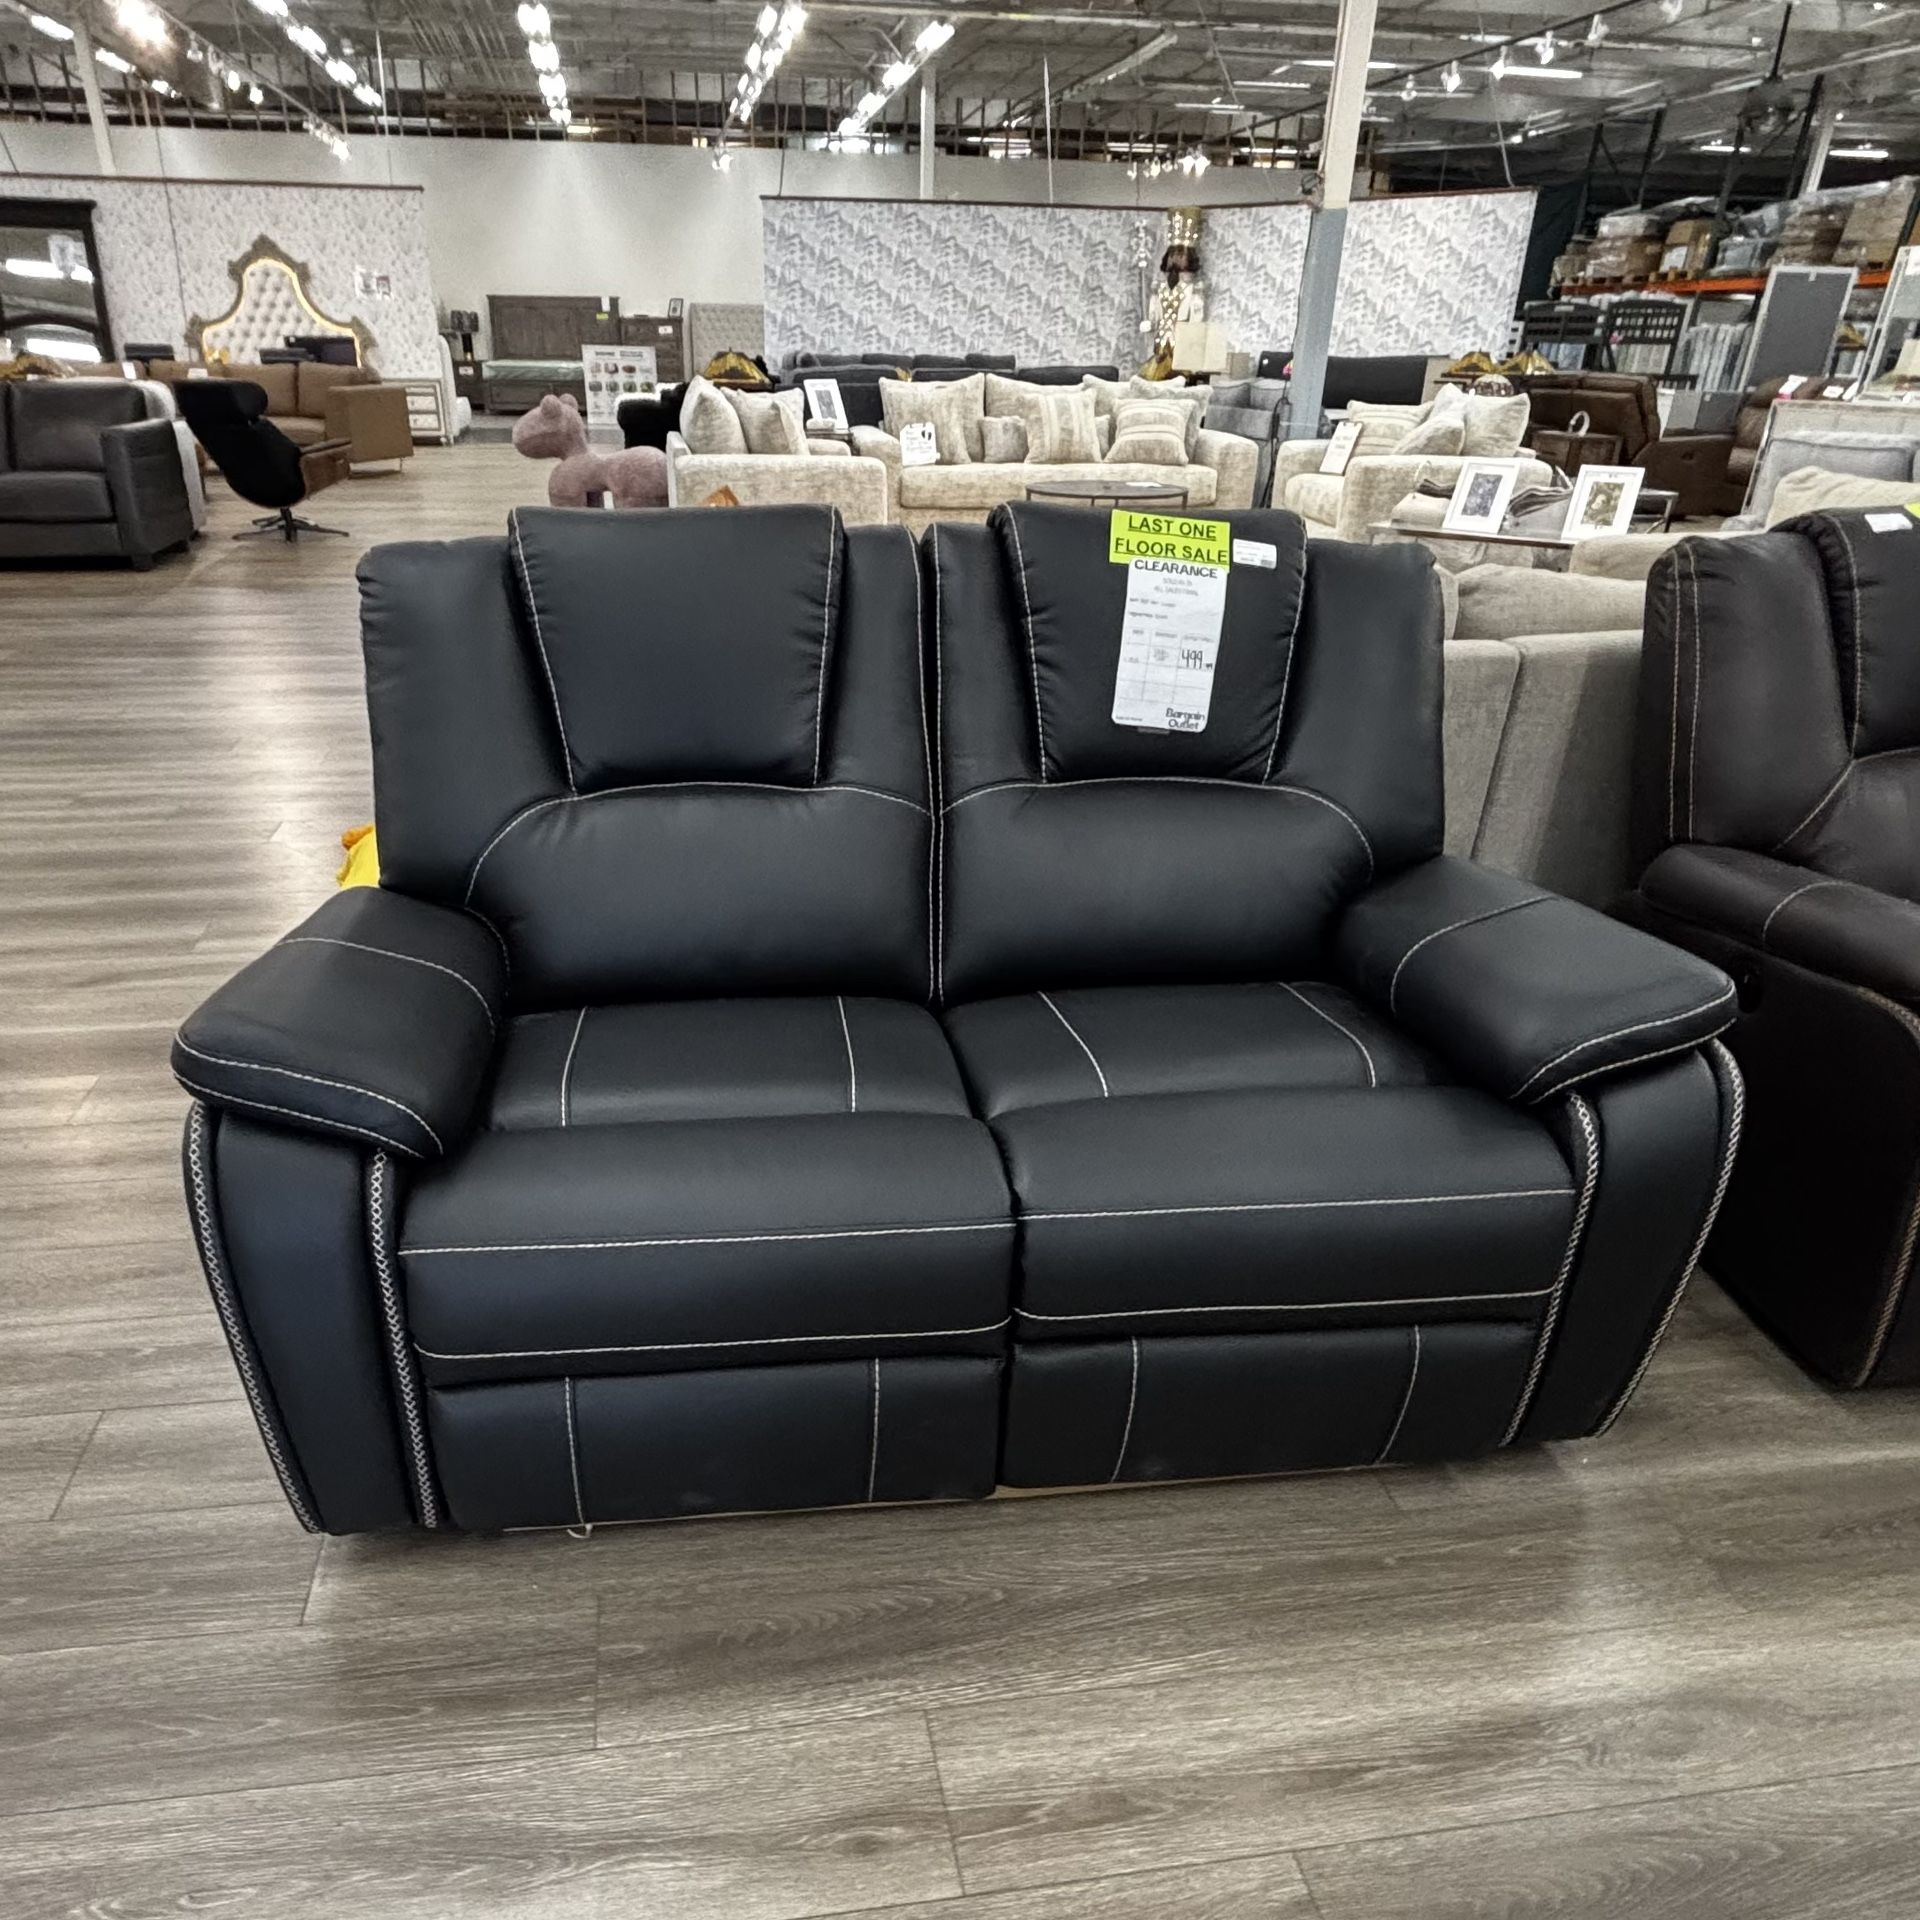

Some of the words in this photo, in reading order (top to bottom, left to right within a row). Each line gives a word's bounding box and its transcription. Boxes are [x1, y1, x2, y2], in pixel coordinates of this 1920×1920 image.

[1128, 514, 1174, 532] LAST
[1179, 522, 1216, 539] ONE
[1115, 537, 1176, 557] FLOOR
[1182, 545, 1228, 563] SALE
[1134, 559, 1218, 579] CLEARANCE
[1181, 649, 1203, 670] 499
[1165, 708, 1205, 723] Bargain
[1168, 718, 1199, 730] Outlet
